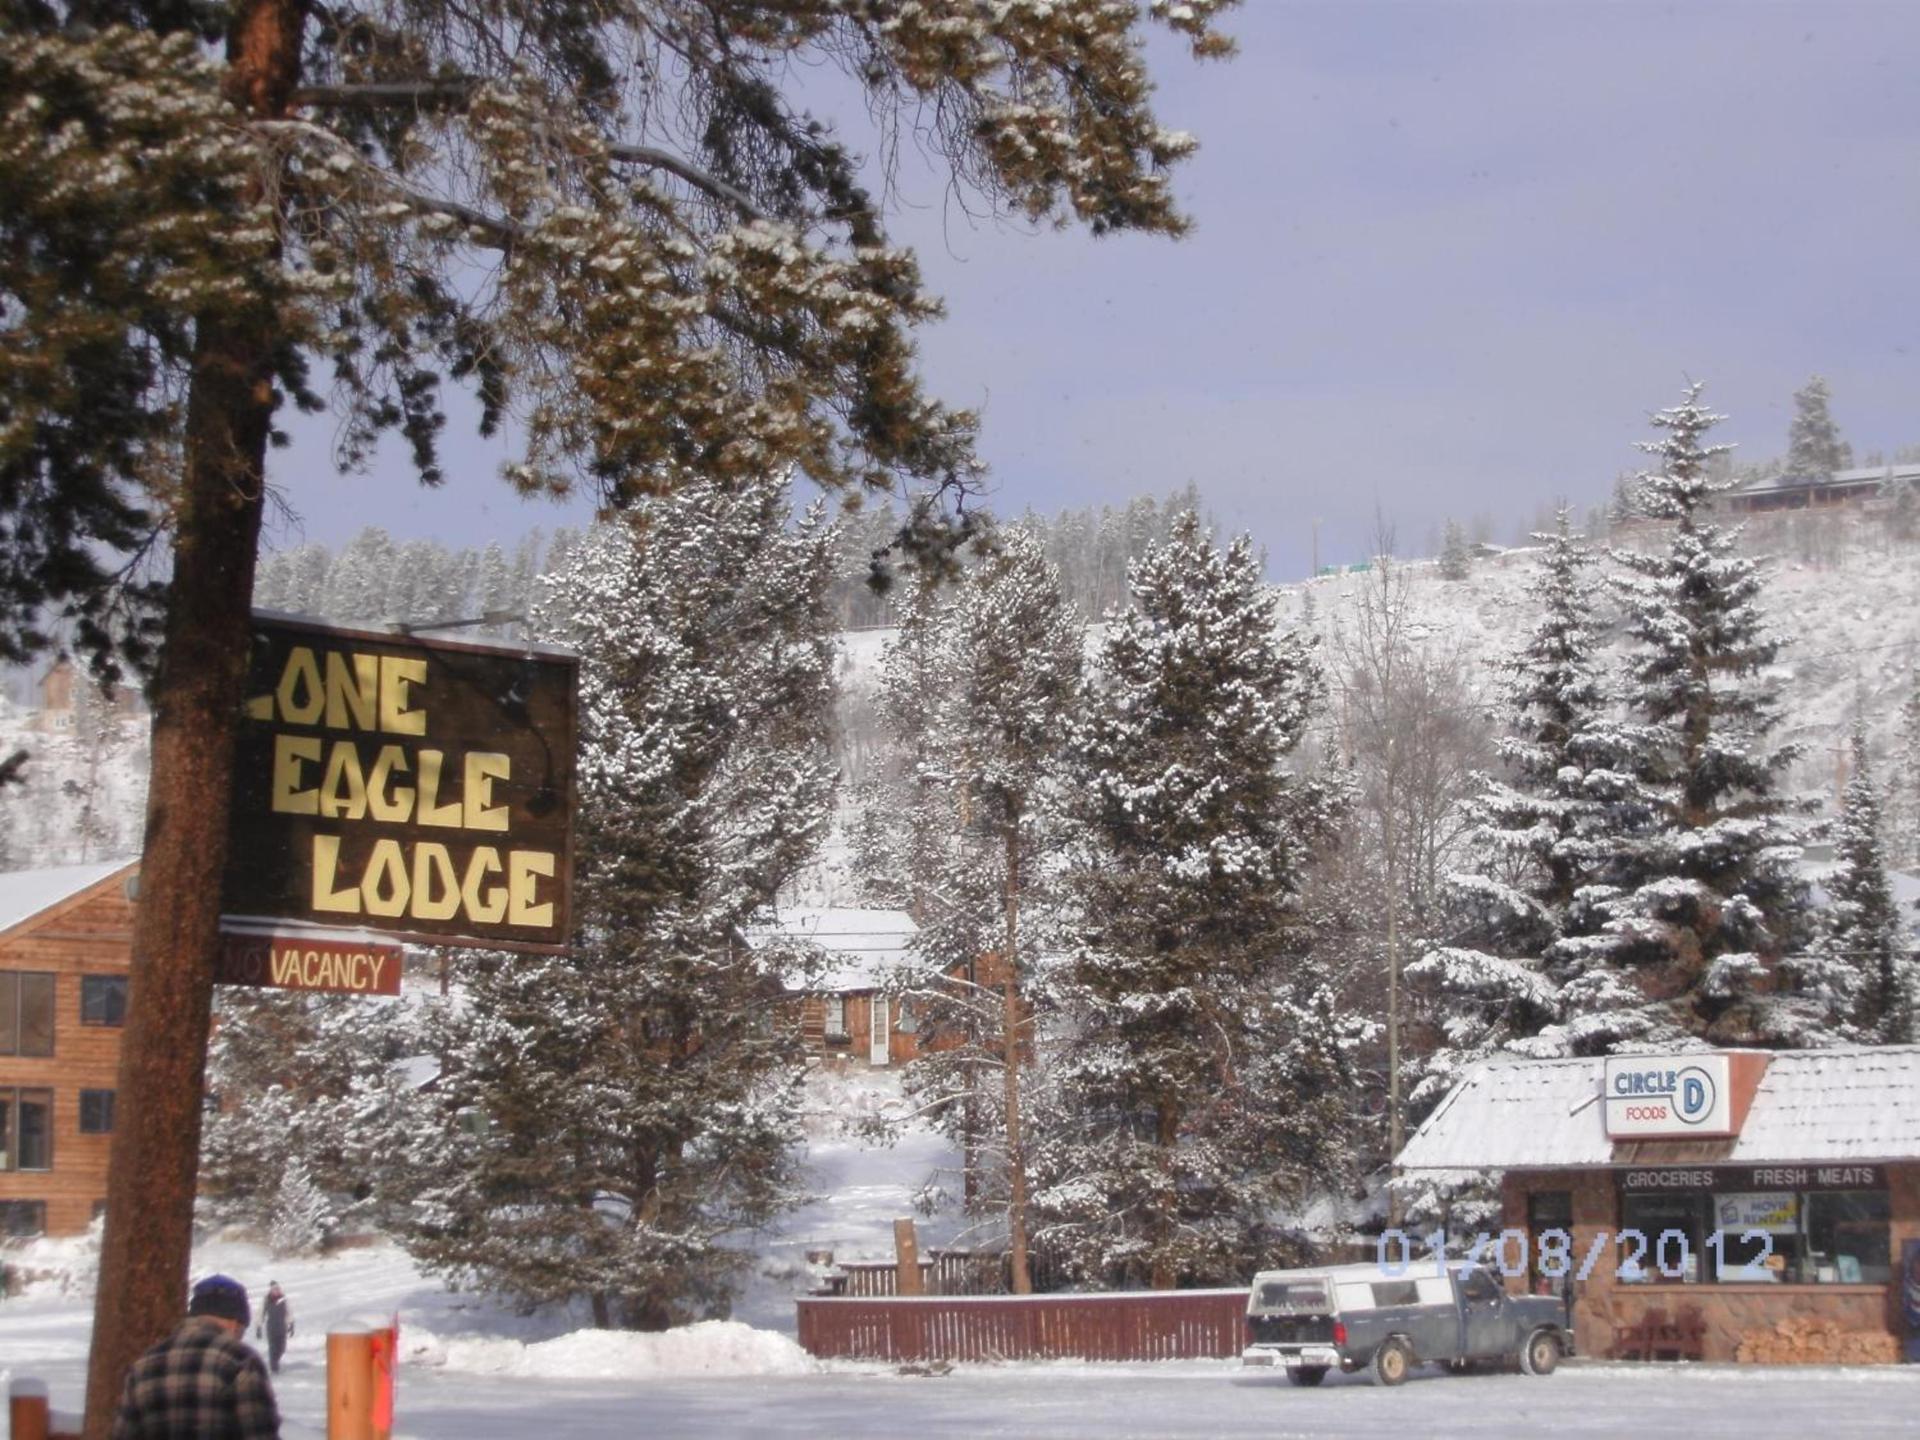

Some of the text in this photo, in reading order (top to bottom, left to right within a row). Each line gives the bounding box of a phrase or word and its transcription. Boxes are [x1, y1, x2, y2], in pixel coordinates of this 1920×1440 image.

[246, 646, 428, 736] ONE
[271, 734, 511, 832] EAGLE
[312, 834, 555, 928] LODGE
[271, 949, 385, 990] VACANCY
[1614, 1070, 1705, 1115] CIRCLE D
[1625, 1105, 1667, 1121] FOODS
[1626, 1170, 1713, 1188] GROCERIES
[1753, 1168, 1874, 1185] FRESH MEATS
